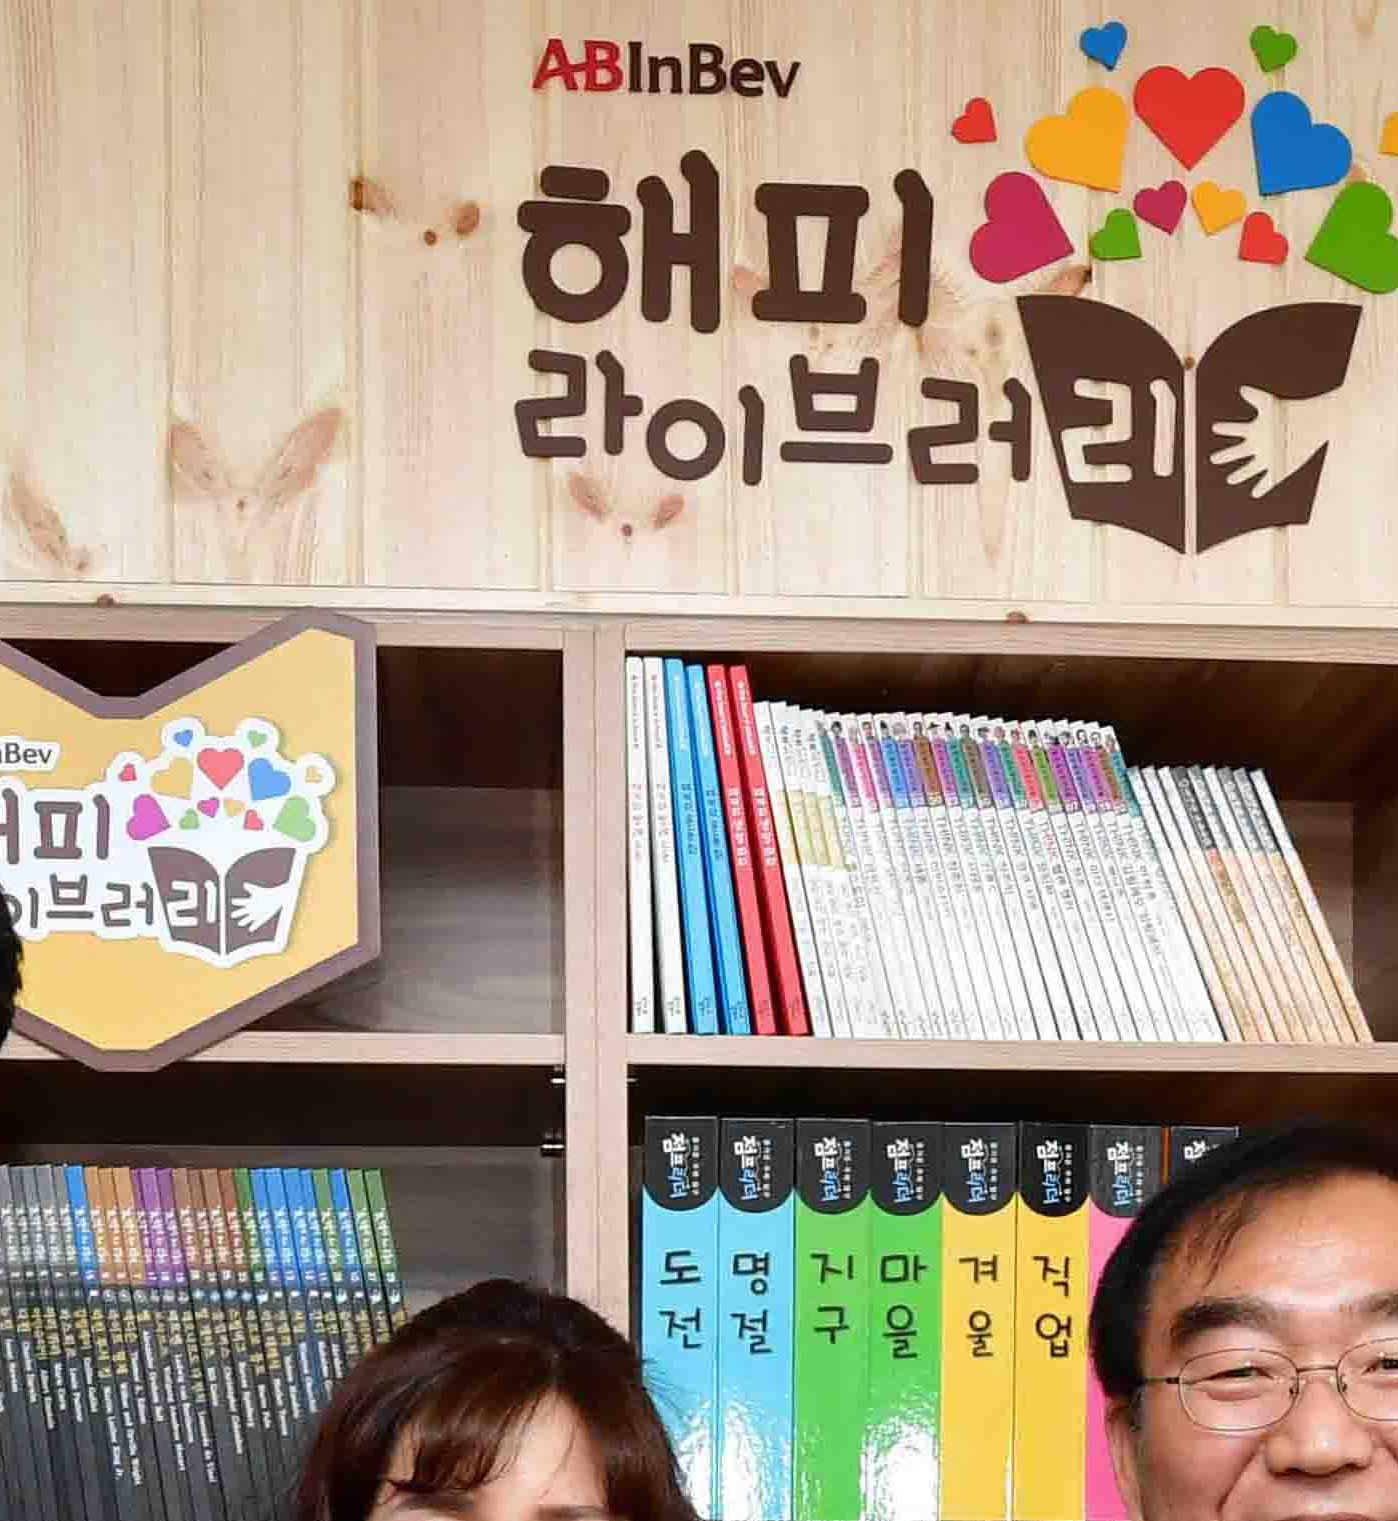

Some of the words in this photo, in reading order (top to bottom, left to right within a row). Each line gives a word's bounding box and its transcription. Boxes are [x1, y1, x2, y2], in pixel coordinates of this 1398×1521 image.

[531, 37, 802, 99] ABInBev
[516, 149, 935, 333] 해피
[515, 348, 1178, 487] 라이브러리
[6, 873, 218, 930] 이브러리
[659, 1250, 701, 1349] 도전
[730, 1252, 772, 1354] 명절
[810, 1253, 854, 1345] 지구
[880, 1254, 928, 1359] 마을
[958, 1255, 998, 1358] 겨울
[1033, 1255, 1072, 1358] 직업
